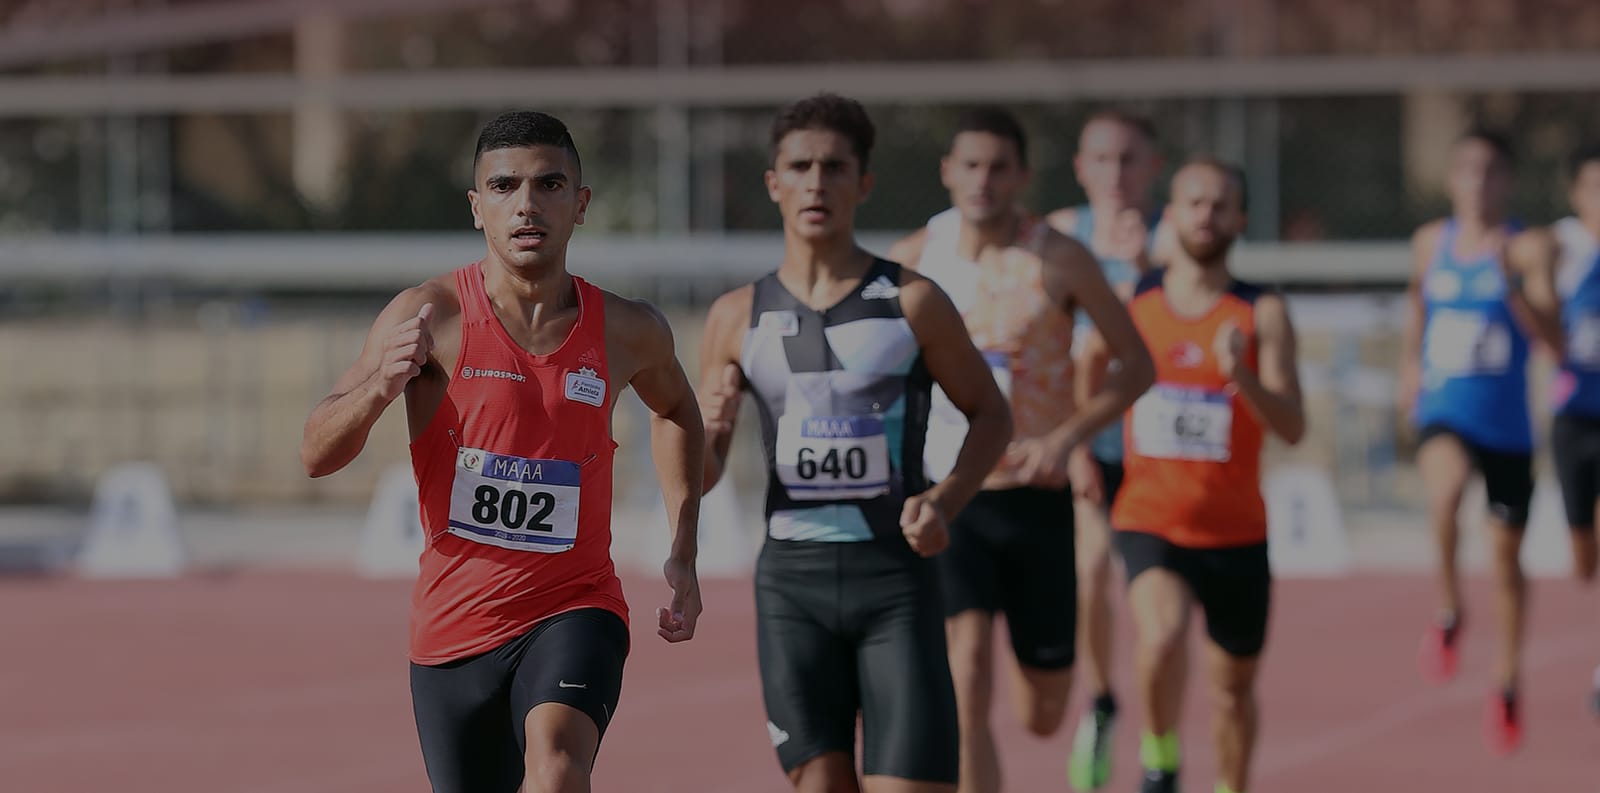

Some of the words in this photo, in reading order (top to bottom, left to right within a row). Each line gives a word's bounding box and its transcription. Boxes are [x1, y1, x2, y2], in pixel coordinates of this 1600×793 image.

[494, 459, 543, 480] MAAA
[797, 447, 866, 480] 640
[472, 485, 555, 532] 802
